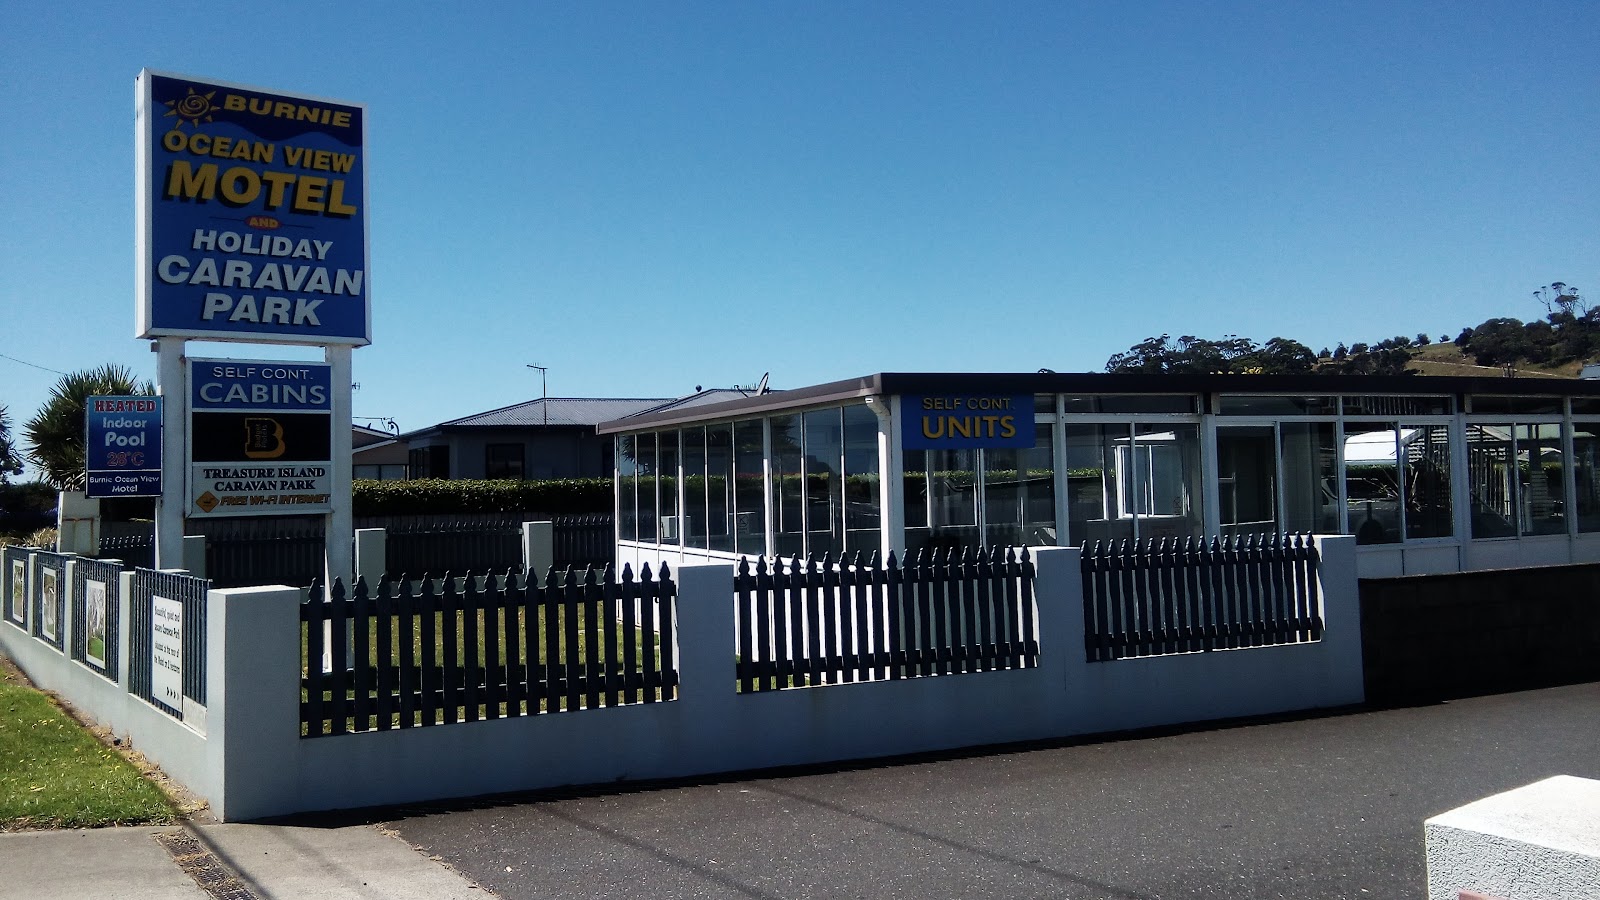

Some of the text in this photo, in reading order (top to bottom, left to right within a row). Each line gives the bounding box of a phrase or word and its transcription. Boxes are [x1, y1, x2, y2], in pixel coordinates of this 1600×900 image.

[224, 94, 352, 128] BURNIE
[163, 129, 356, 174] OCEAN VIEW
[167, 159, 358, 216] MOTEL
[249, 217, 279, 229] AND
[192, 228, 334, 260] HOLIDAY
[158, 254, 364, 296] CARAVAN
[202, 292, 325, 326] PARK
[212, 366, 314, 380] SELF CONT.
[200, 382, 327, 405] CABINS
[94, 400, 157, 413] HEATED
[922, 397, 962, 410] SELF
[102, 416, 147, 429] Indoor
[922, 415, 1016, 439] UNITS
[104, 431, 145, 447] Pool
[89, 476, 113, 484] Burnie
[114, 475, 139, 483] Ocean
[203, 467, 326, 479] TREASURE ISLAND
[111, 484, 138, 493] Motel
[214, 479, 316, 492] CARAVAN PARK
[220, 493, 331, 506] FREE WI-FI INTERNET
